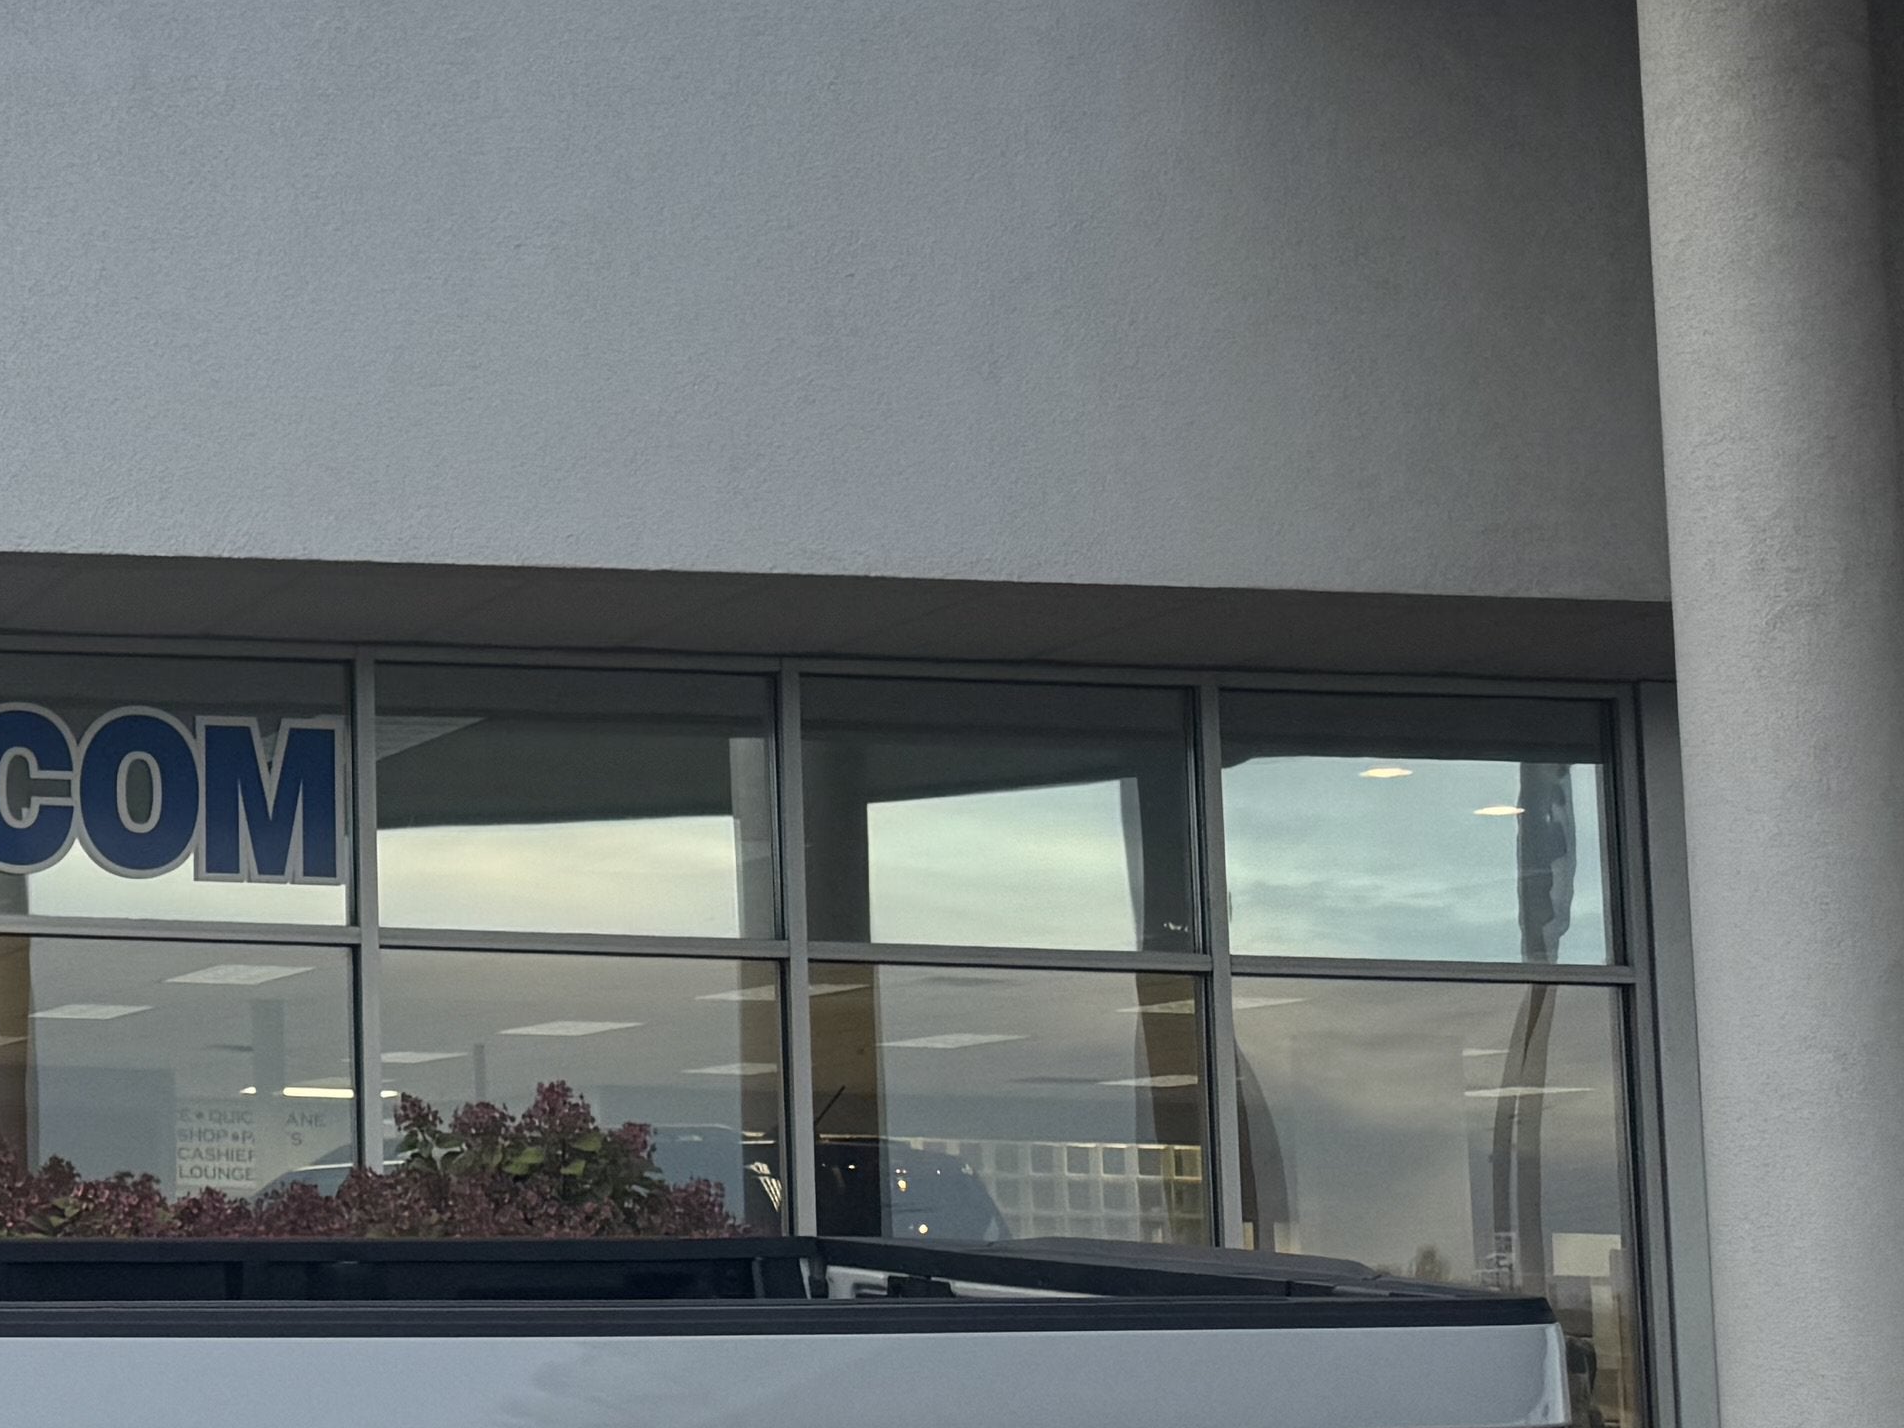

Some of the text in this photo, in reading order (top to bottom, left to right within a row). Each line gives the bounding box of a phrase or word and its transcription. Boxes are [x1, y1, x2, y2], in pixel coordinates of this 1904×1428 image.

[207, 1108, 255, 1126] QUIC
[284, 1110, 327, 1128] ANE
[177, 1127, 229, 1144] SHOP
